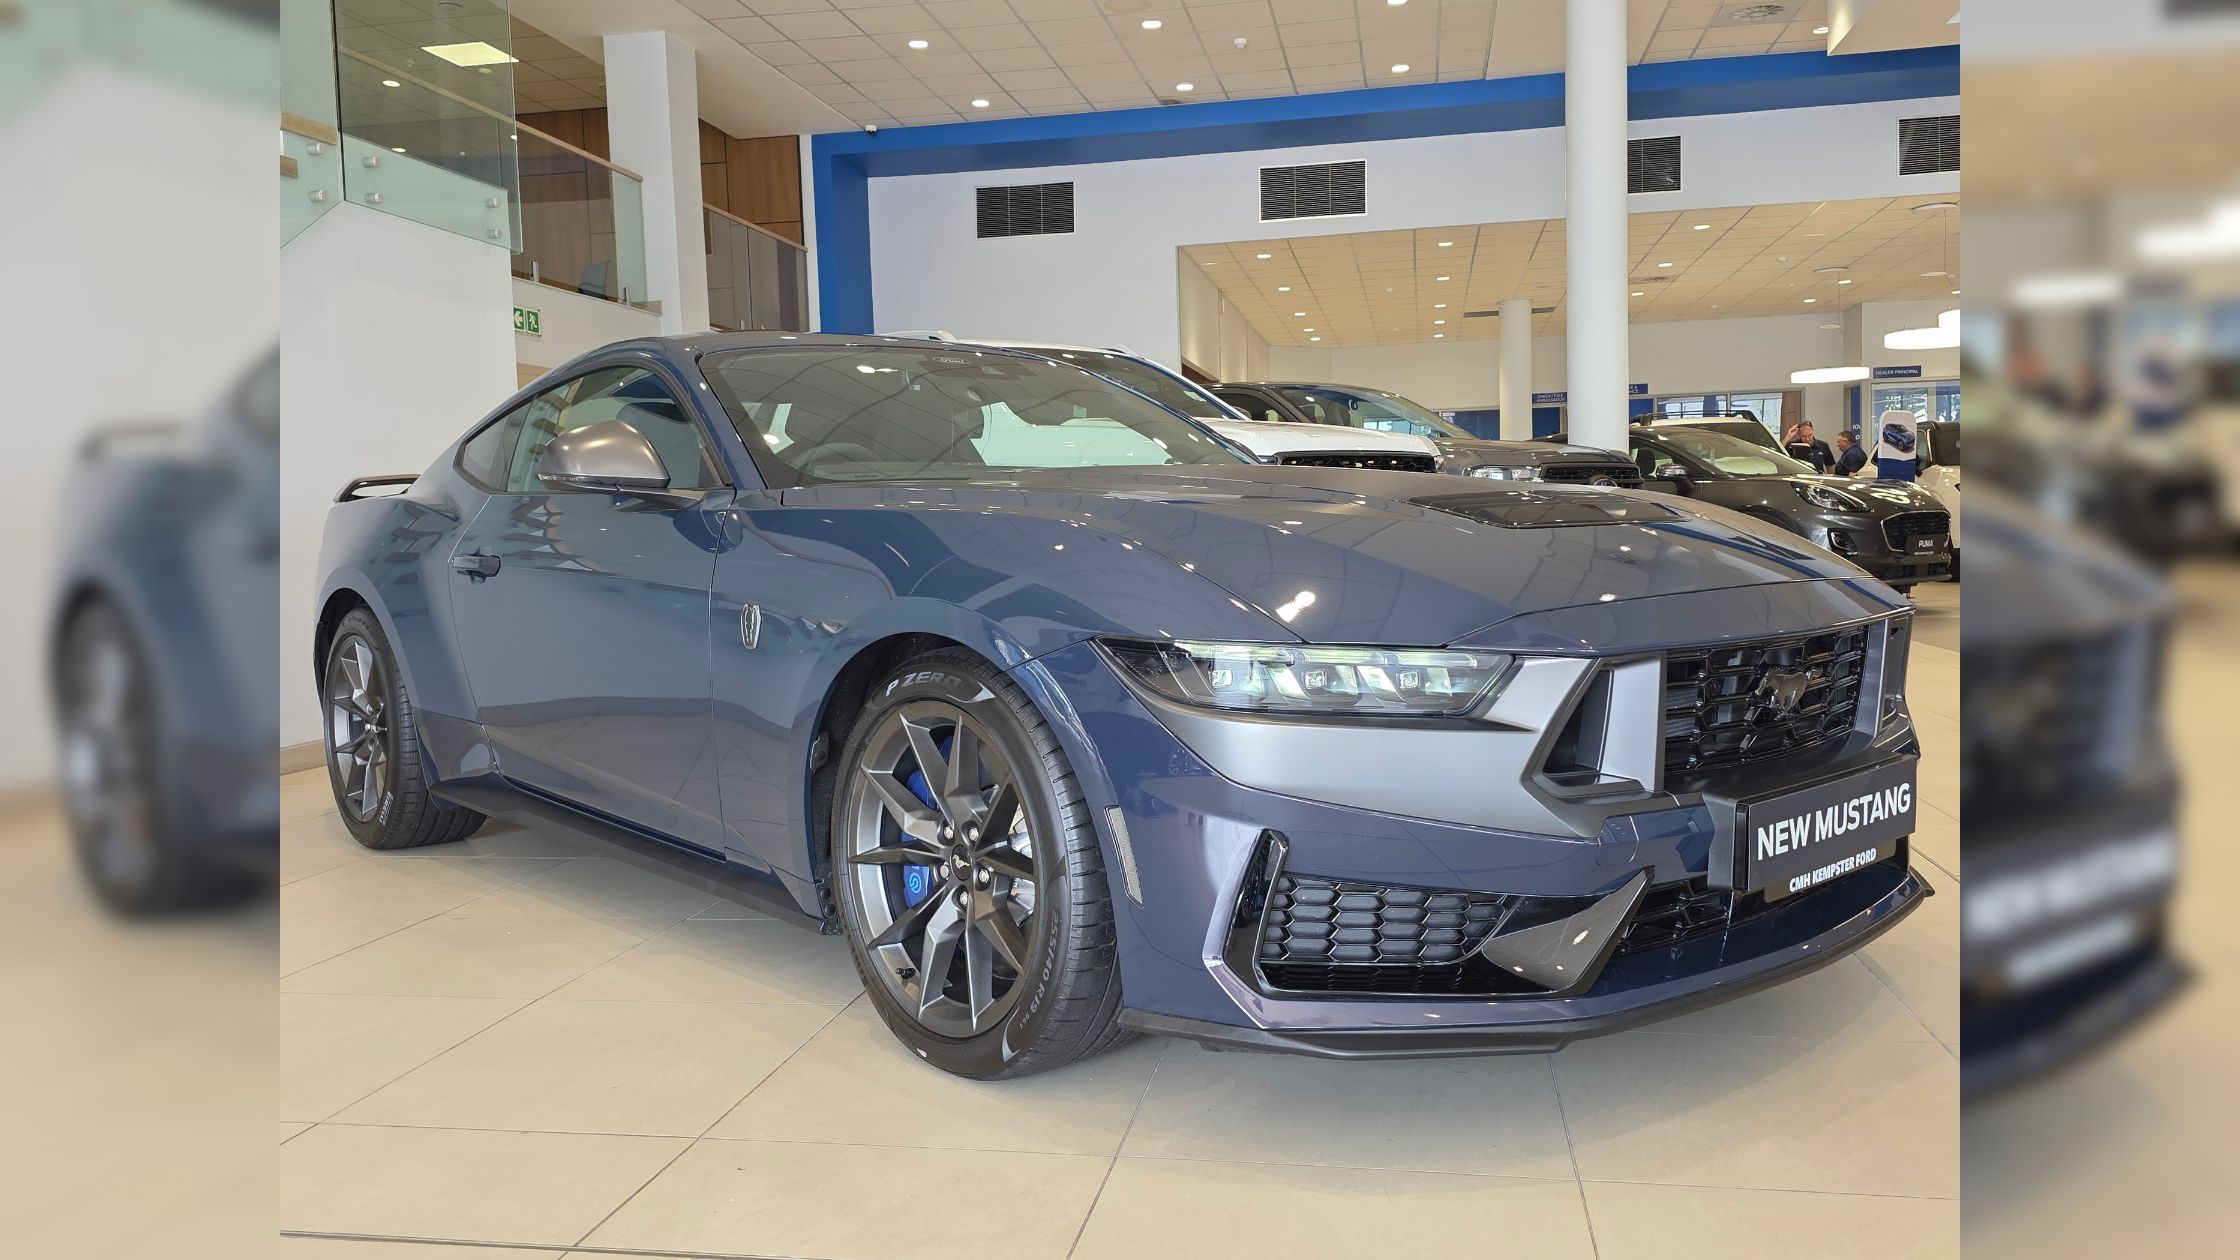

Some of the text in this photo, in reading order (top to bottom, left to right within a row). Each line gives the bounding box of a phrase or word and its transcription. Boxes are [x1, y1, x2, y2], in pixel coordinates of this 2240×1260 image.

[1919, 539, 1934, 548] PUMA
[885, 679, 899, 697] P
[1757, 782, 1911, 861] NEW MUSTANG
[1789, 847, 1877, 893] CMH KEMPSTER FORD
